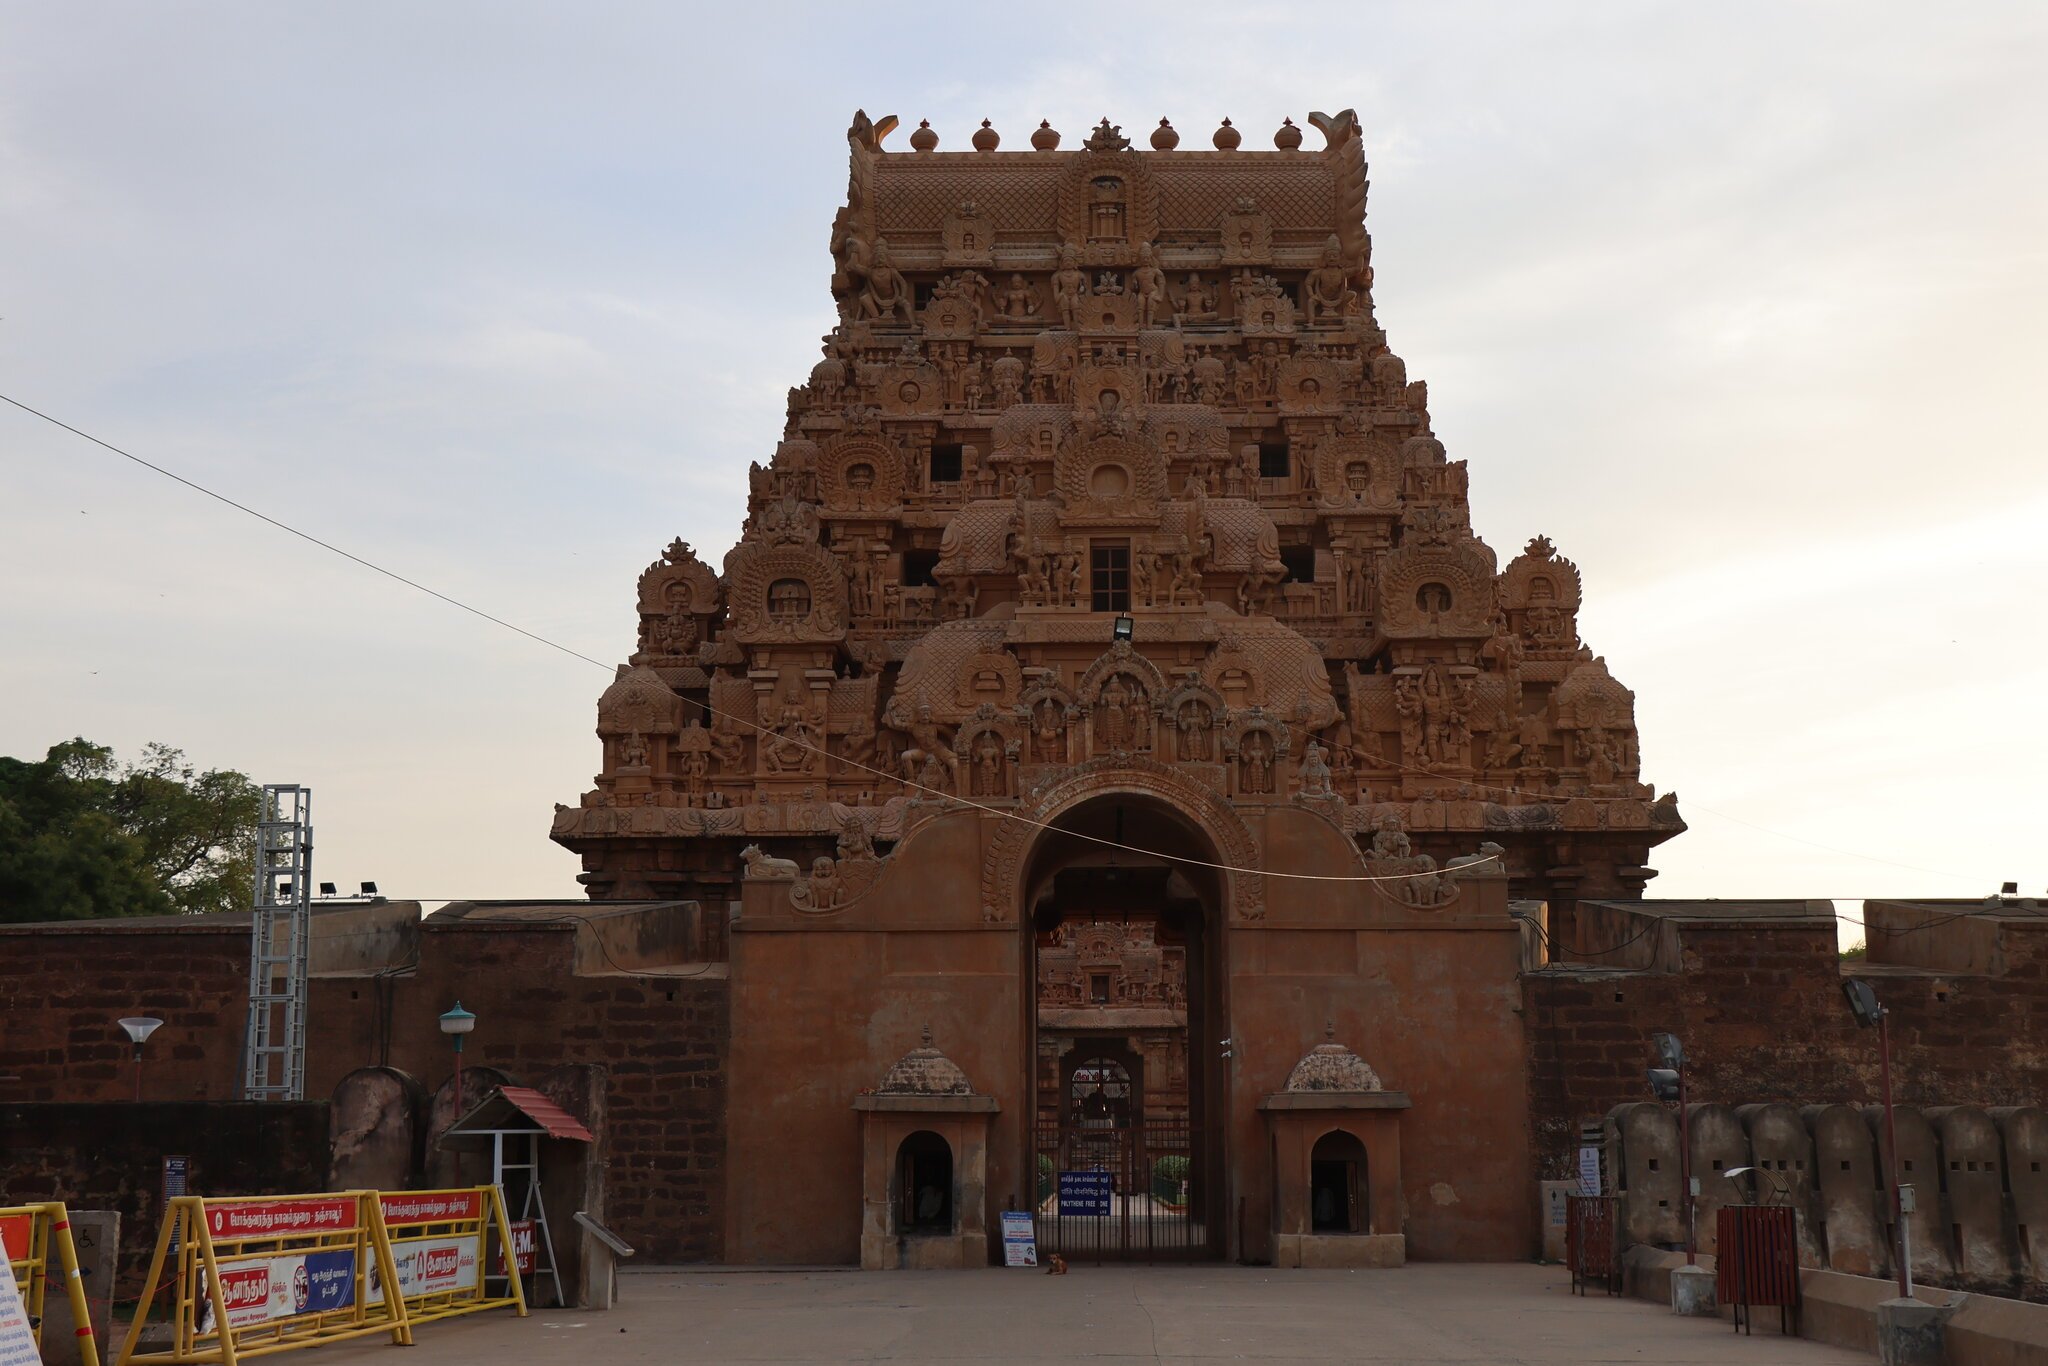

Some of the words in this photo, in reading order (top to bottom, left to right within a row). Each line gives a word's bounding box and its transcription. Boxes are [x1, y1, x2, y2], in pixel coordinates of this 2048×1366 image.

[230, 1209, 273, 1228] போக்குவரத்து
[274, 1208, 310, 1227] காவல்துறை
[314, 1204, 343, 1224] தஞ்சாவூர்
[427, 1250, 457, 1276] ஆனந்தம்
[221, 1271, 268, 1305] ஆனந்தம்
